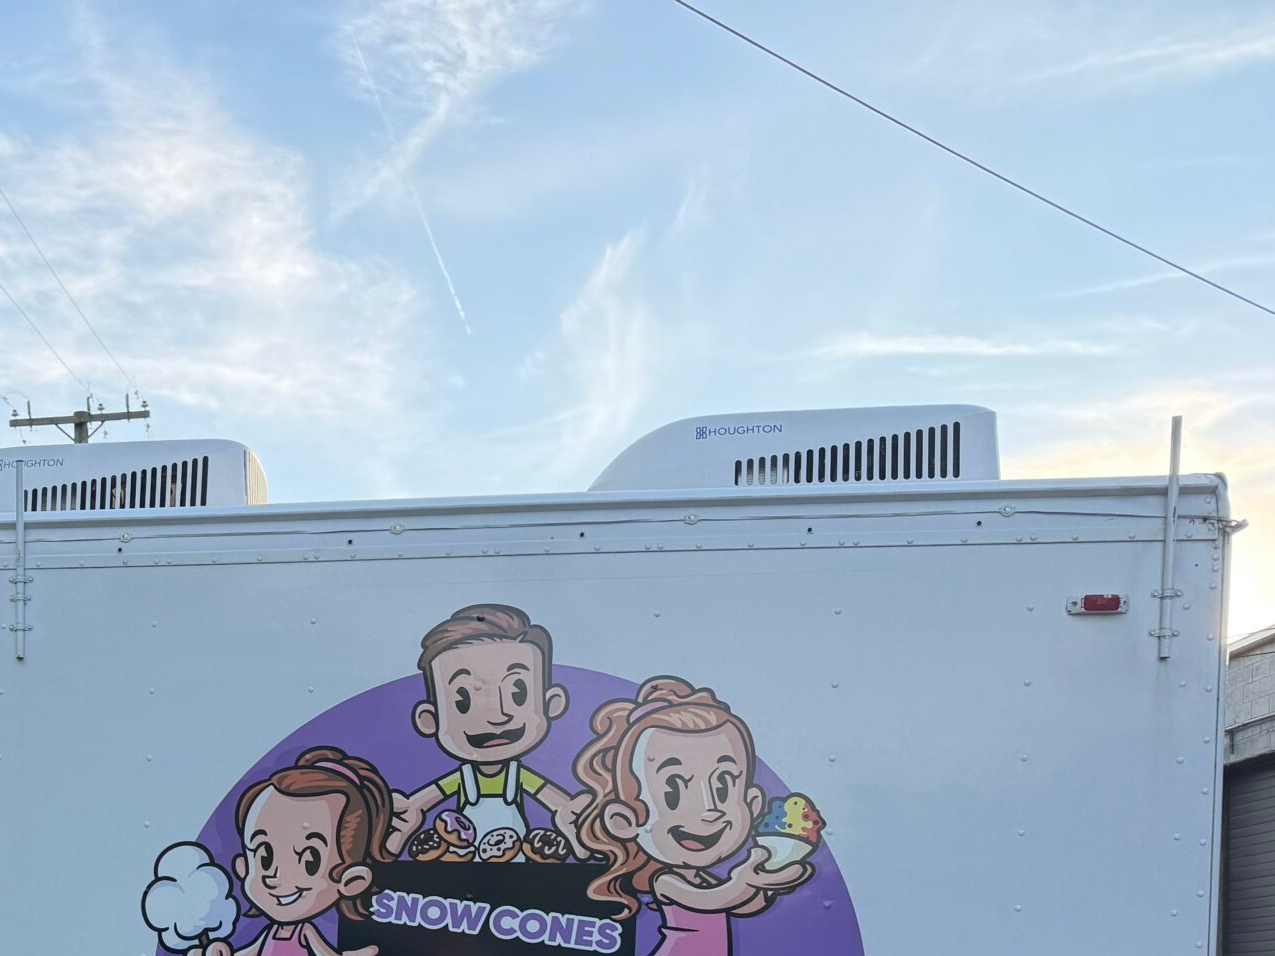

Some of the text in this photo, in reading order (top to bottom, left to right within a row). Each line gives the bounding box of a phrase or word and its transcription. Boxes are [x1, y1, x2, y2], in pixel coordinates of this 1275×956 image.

[708, 424, 783, 436] HOUGHTON
[3, 458, 64, 469] HOGHTON
[373, 891, 620, 951] SNOW CONES
